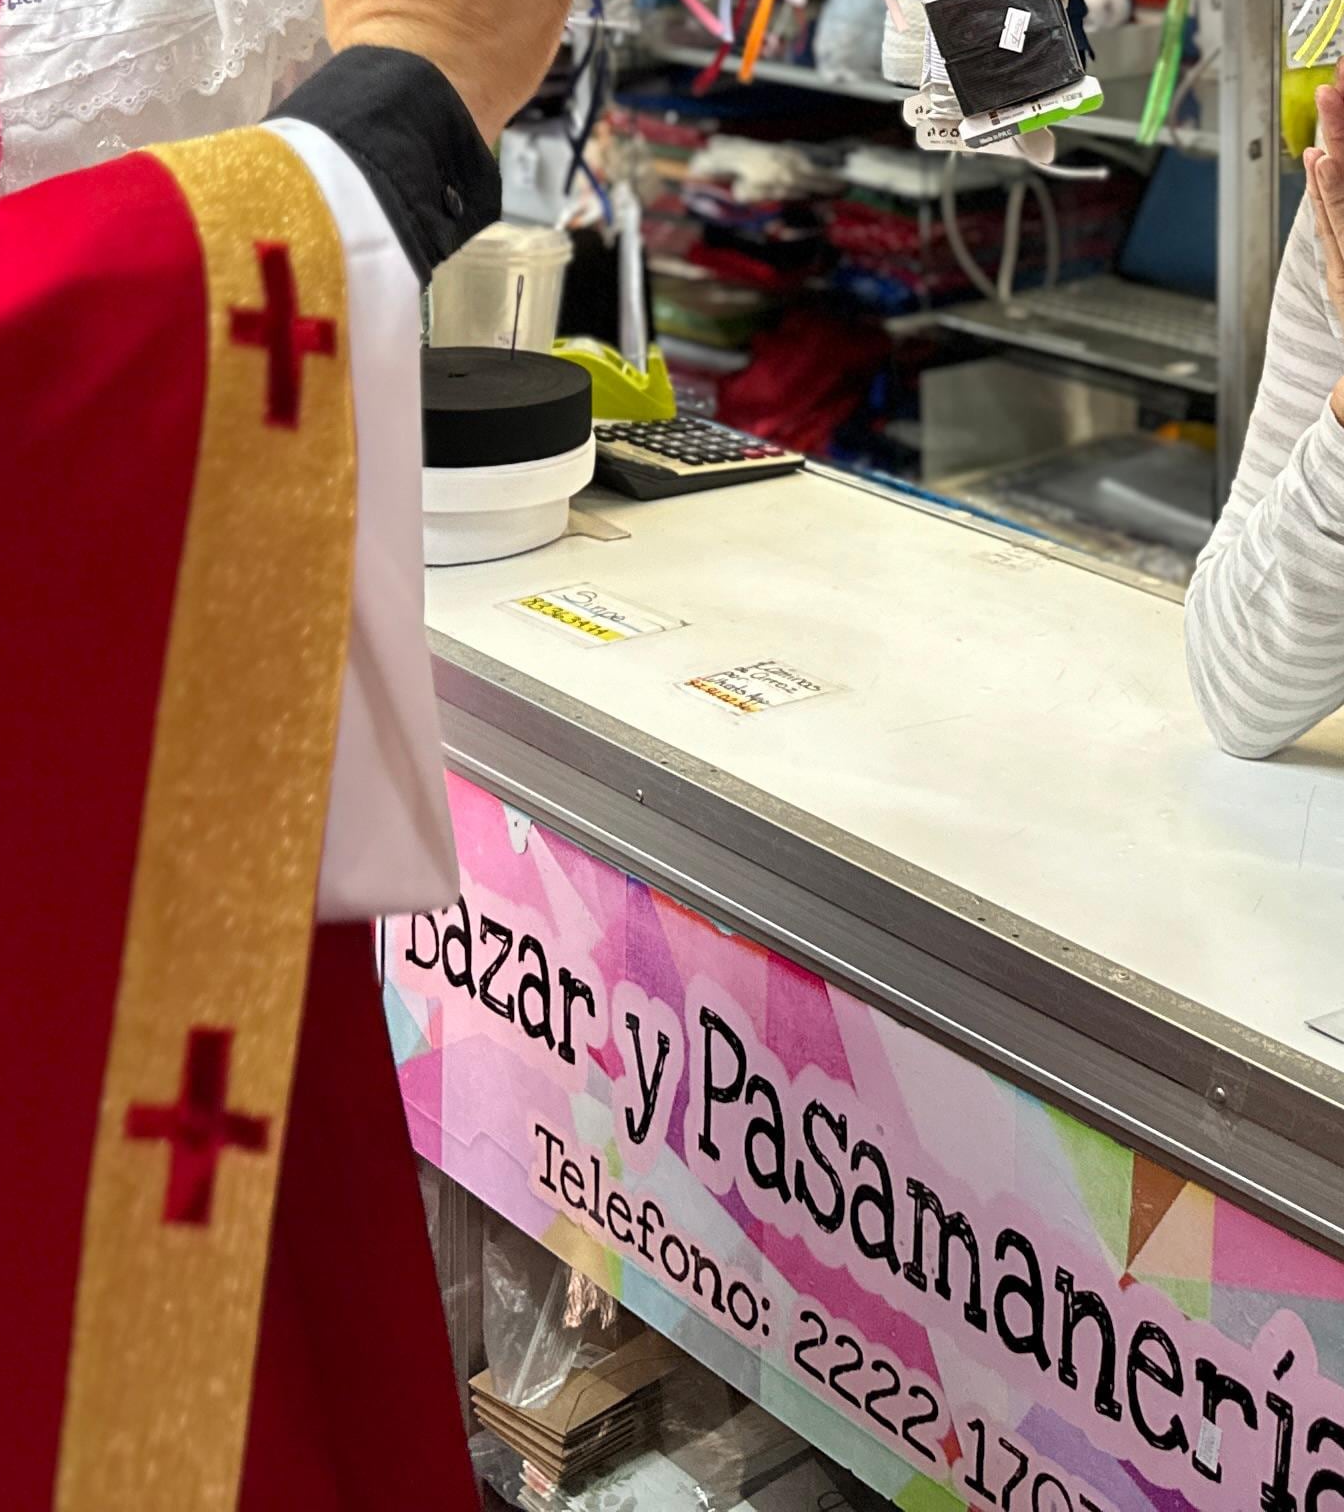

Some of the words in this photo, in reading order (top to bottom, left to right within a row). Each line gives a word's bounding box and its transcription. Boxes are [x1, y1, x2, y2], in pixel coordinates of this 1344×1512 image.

[625, 1012, 670, 1145] y
[534, 1123, 773, 1338] Telefono:
[793, 1310, 945, 1460] 2222
